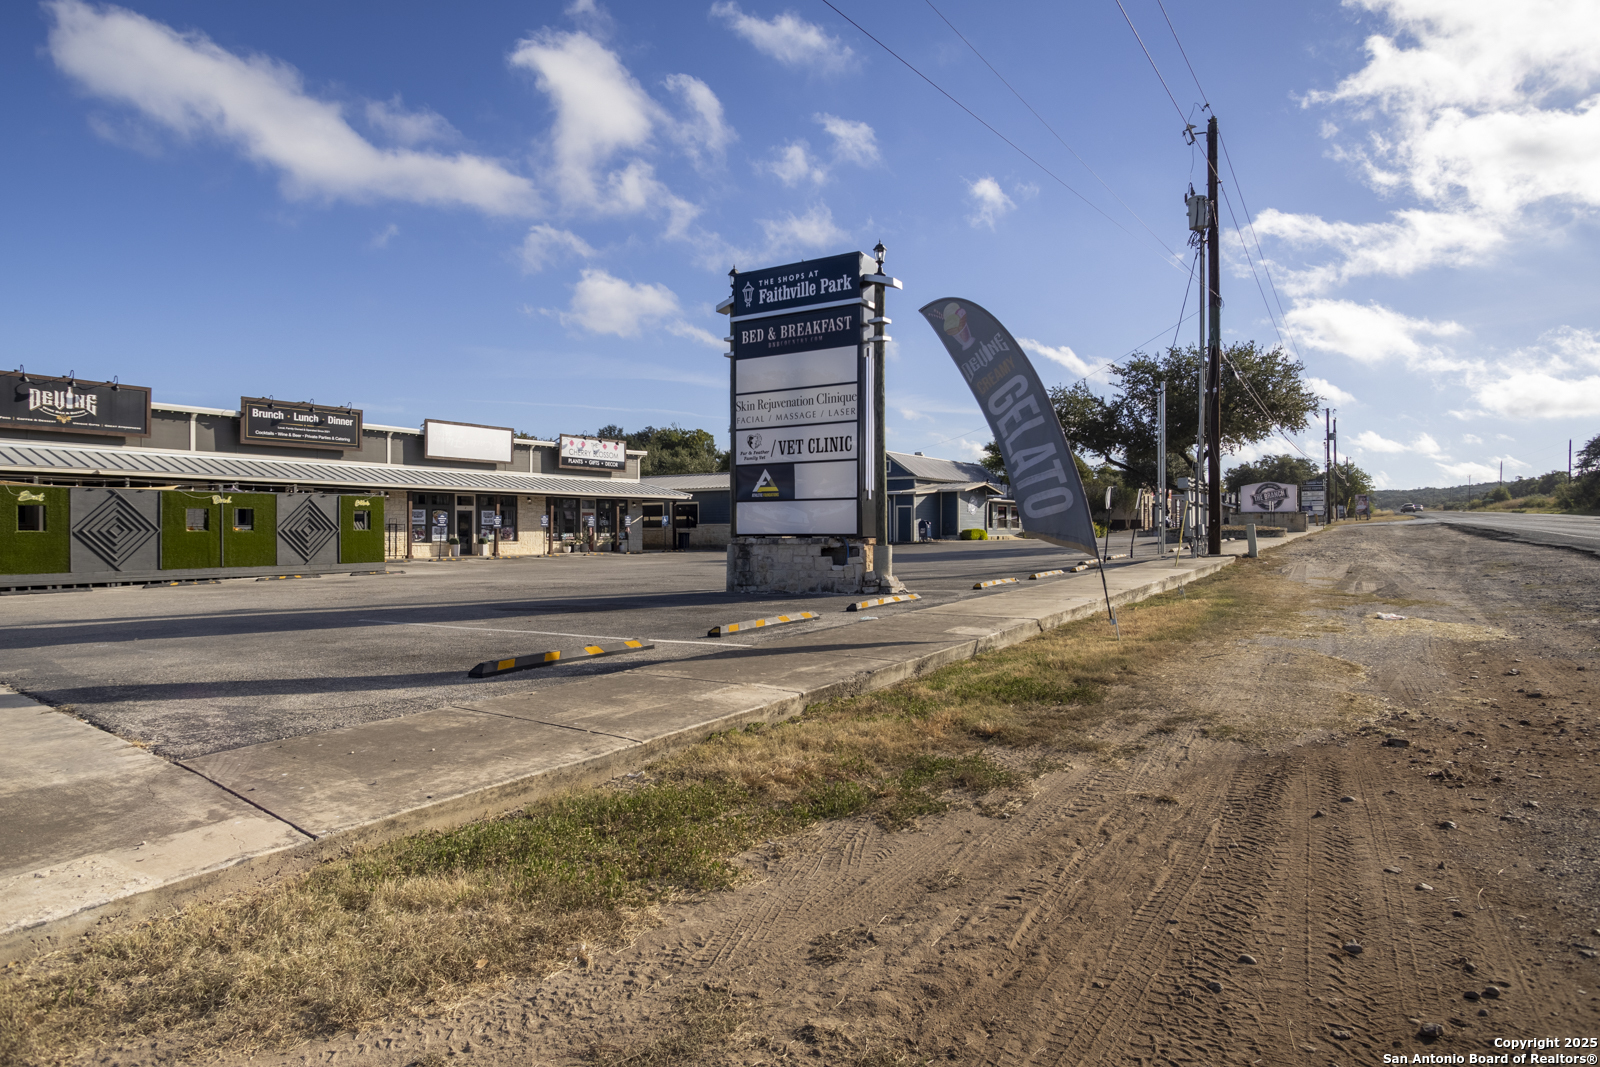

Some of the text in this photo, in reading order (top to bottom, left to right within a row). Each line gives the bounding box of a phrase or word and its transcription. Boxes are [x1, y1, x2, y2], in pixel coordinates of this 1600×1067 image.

[759, 270, 819, 286] THE SHOPS AT
[758, 274, 852, 304] Faithville Park
[741, 315, 852, 345] BED & BREAKFAST
[976, 355, 1016, 396] CREAMY
[735, 391, 858, 413] Skin Rejuvenation Clinique
[252, 408, 354, 426] Brunch Lunch Dinner
[736, 416, 765, 425] FACIAL
[776, 411, 816, 421] MASSAGE
[828, 407, 856, 417] LASER
[568, 448, 619, 459] CHERRY BLOSSOM
[778, 435, 853, 456] VET CLINIC
[987, 374, 1074, 519] GELATO
[1253, 490, 1286, 502] THE BRANCH
